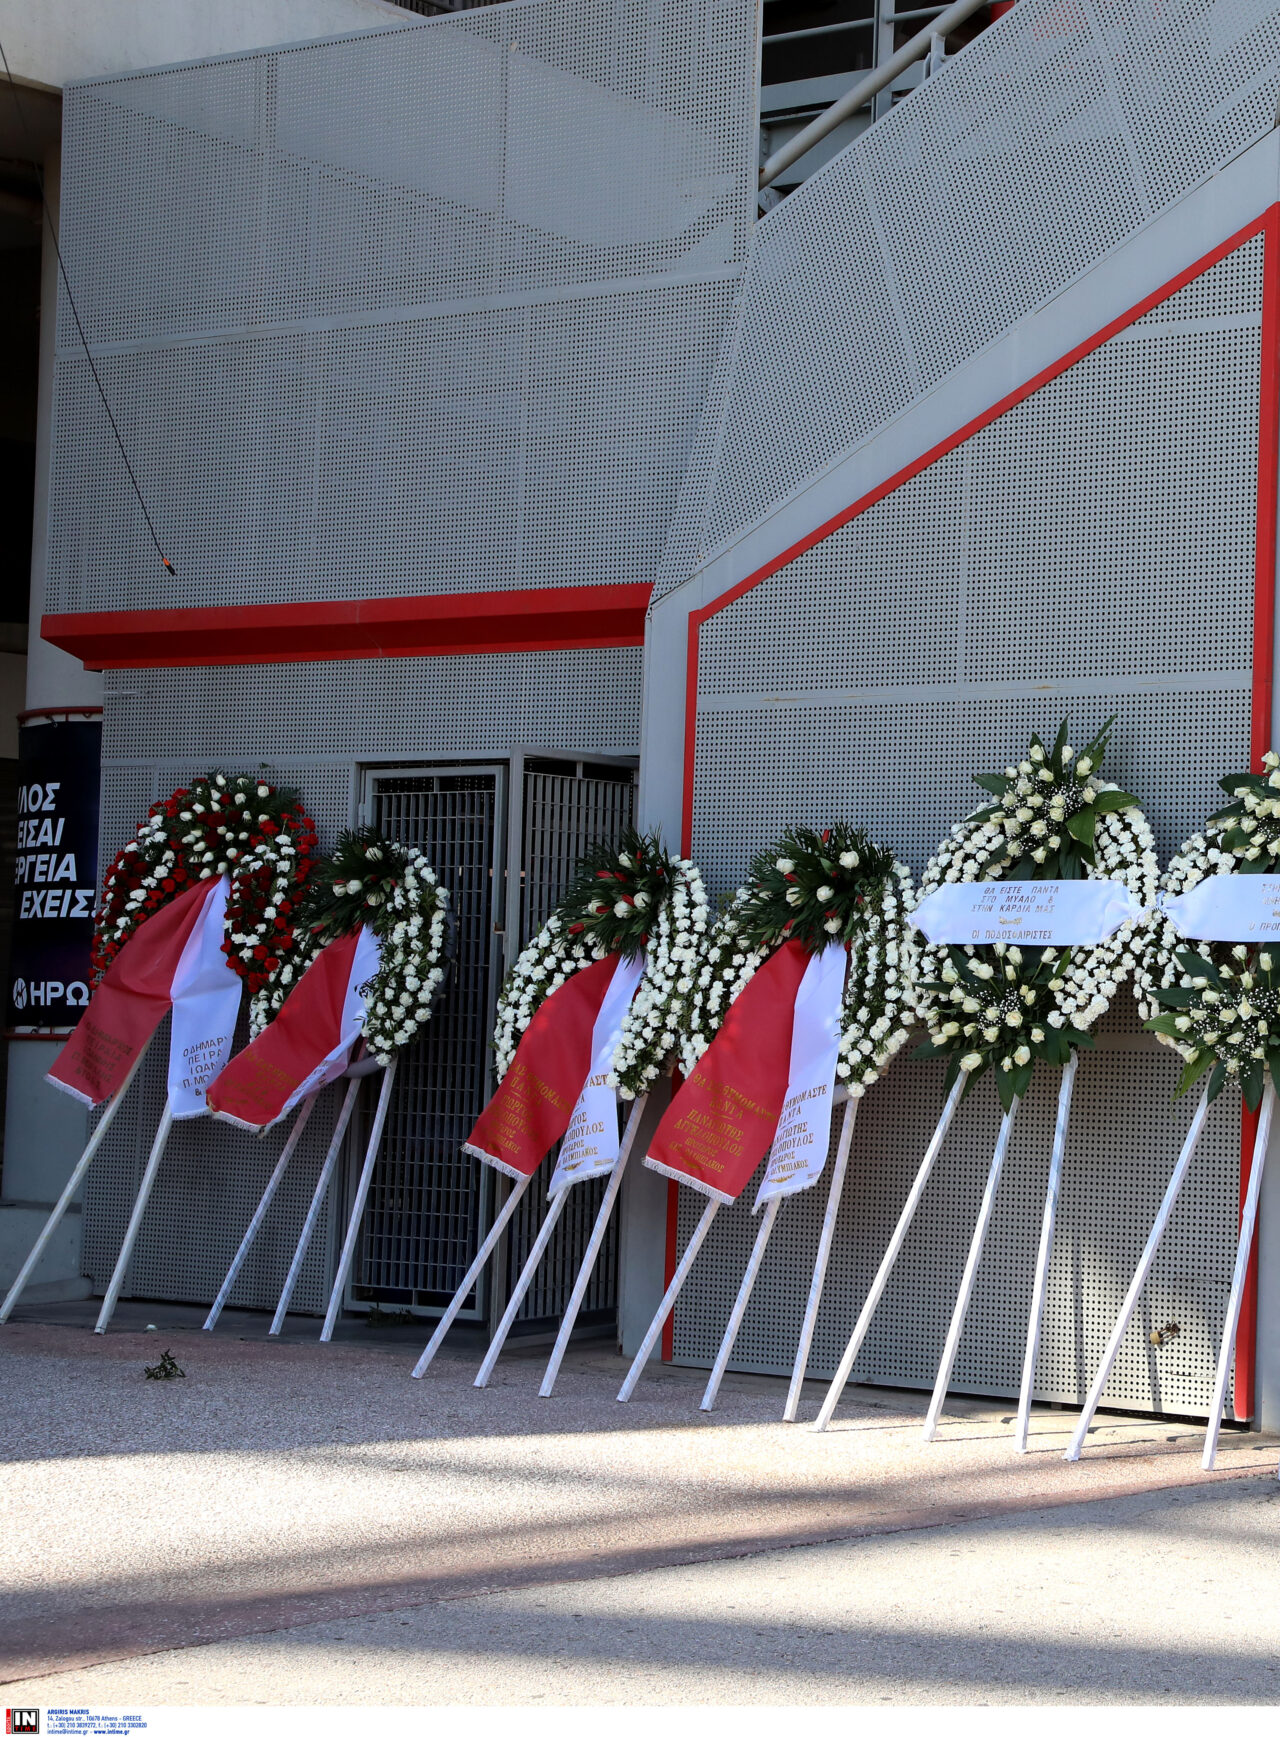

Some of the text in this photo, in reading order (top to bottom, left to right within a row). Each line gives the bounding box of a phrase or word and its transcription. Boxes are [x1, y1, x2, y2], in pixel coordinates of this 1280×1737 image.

[1000, 886, 1022, 894] ΕΙΣΤΕ
[1031, 886, 1059, 894] ΠΑΝΤΑ
[999, 904, 1031, 912] ΚΑΡΔΙΑ
[190, 1036, 227, 1054] ΔΗΜΑΡ
